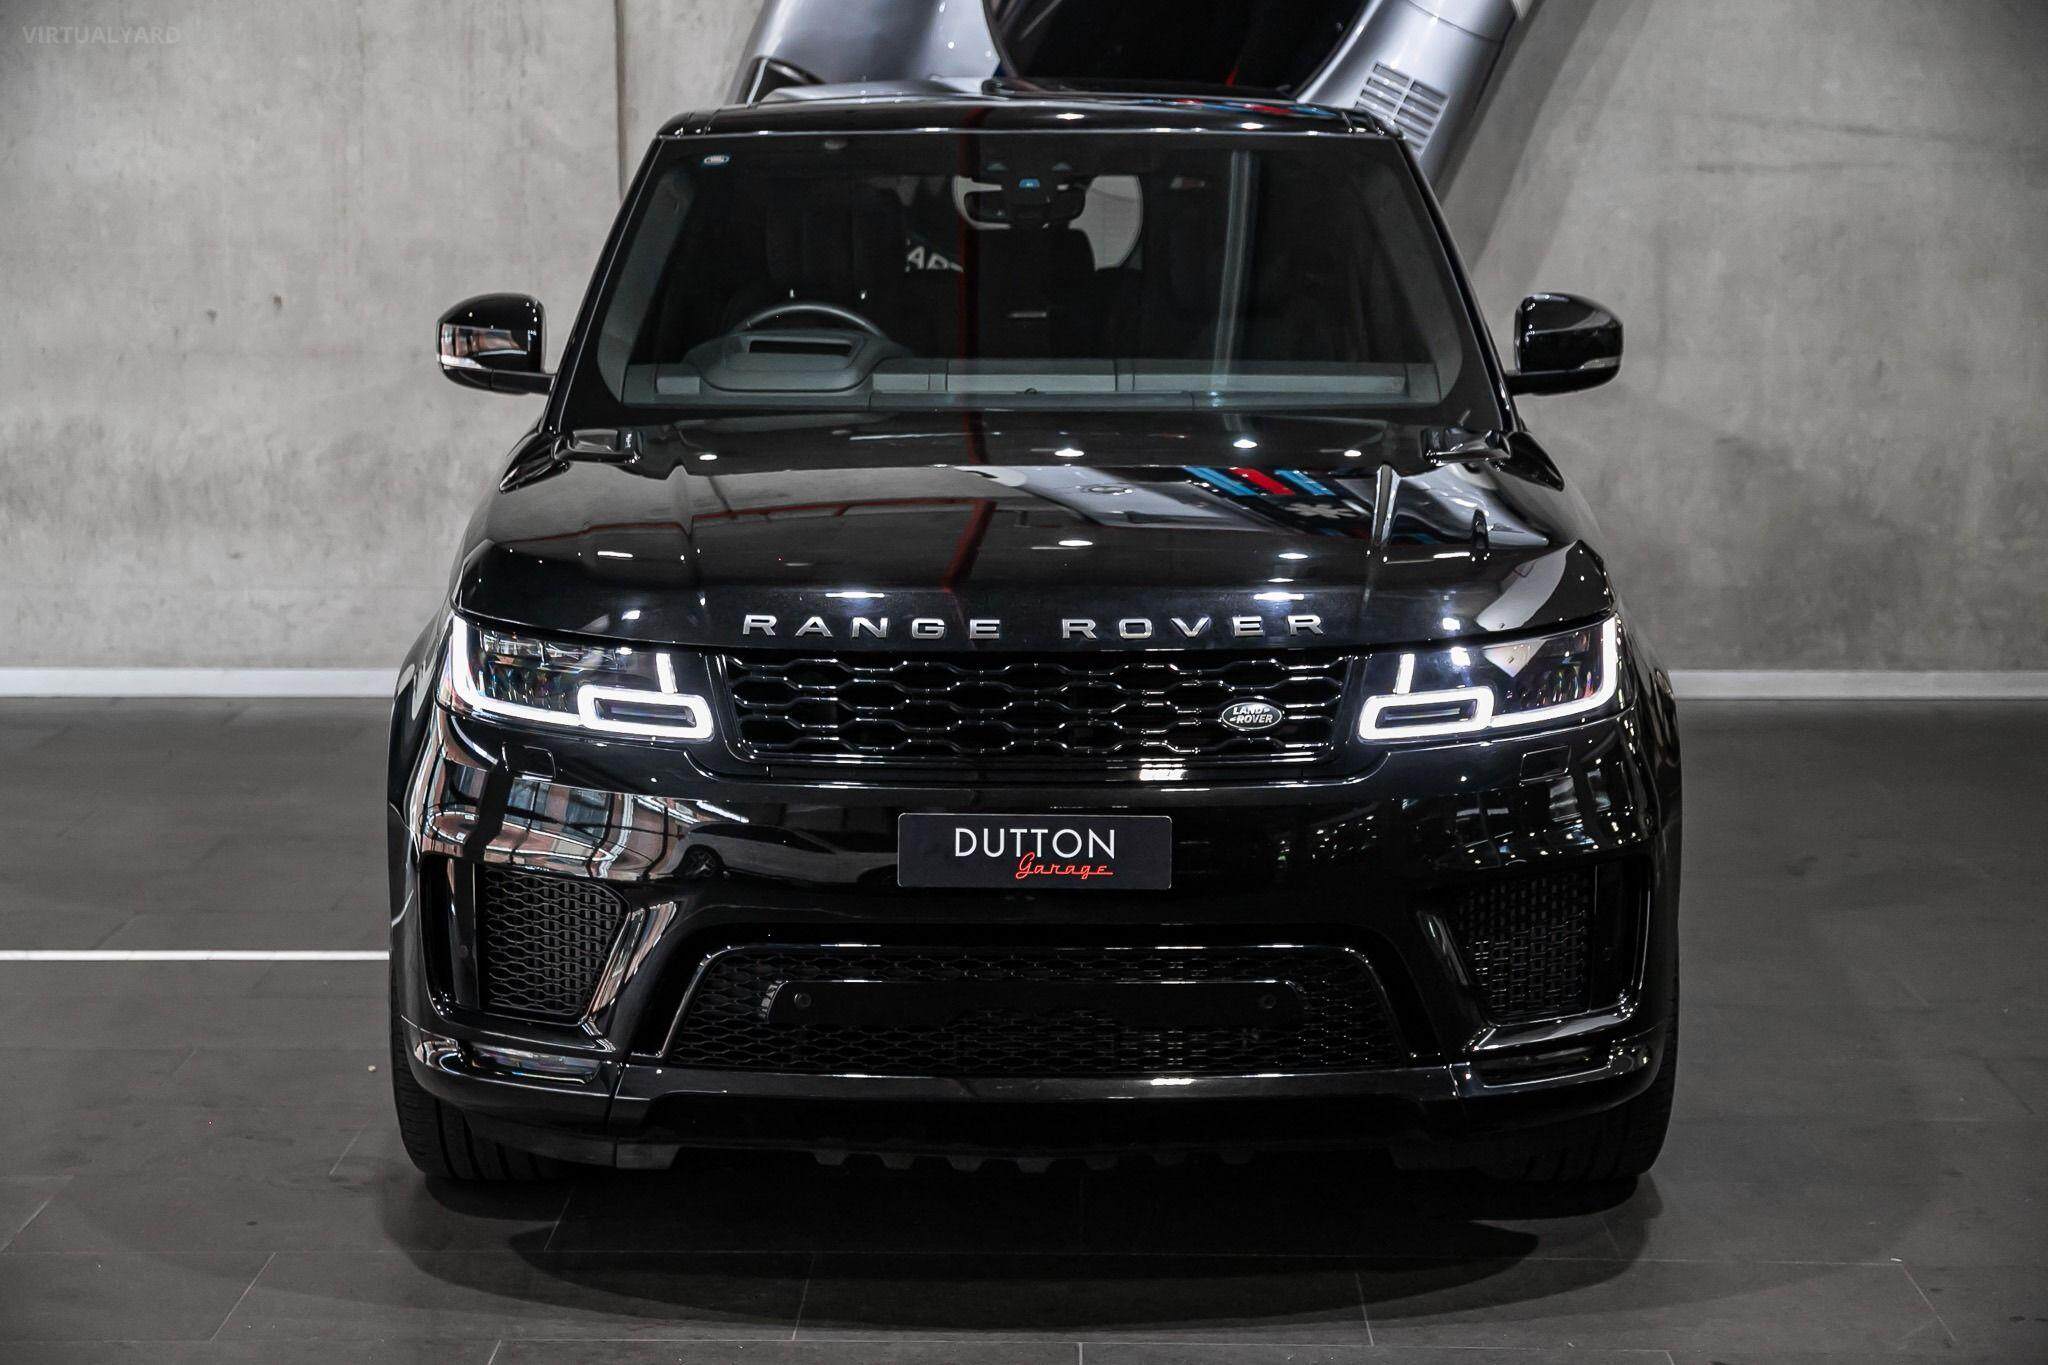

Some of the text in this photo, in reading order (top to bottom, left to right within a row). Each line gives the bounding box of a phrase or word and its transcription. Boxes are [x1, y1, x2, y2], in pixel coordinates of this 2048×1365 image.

[742, 614, 1325, 640] RANGE ROVER
[1232, 704, 1264, 715] LAND
[1236, 713, 1274, 724] ROVER
[955, 828, 1115, 859] DUTTON
[1015, 851, 1114, 880] Garage
